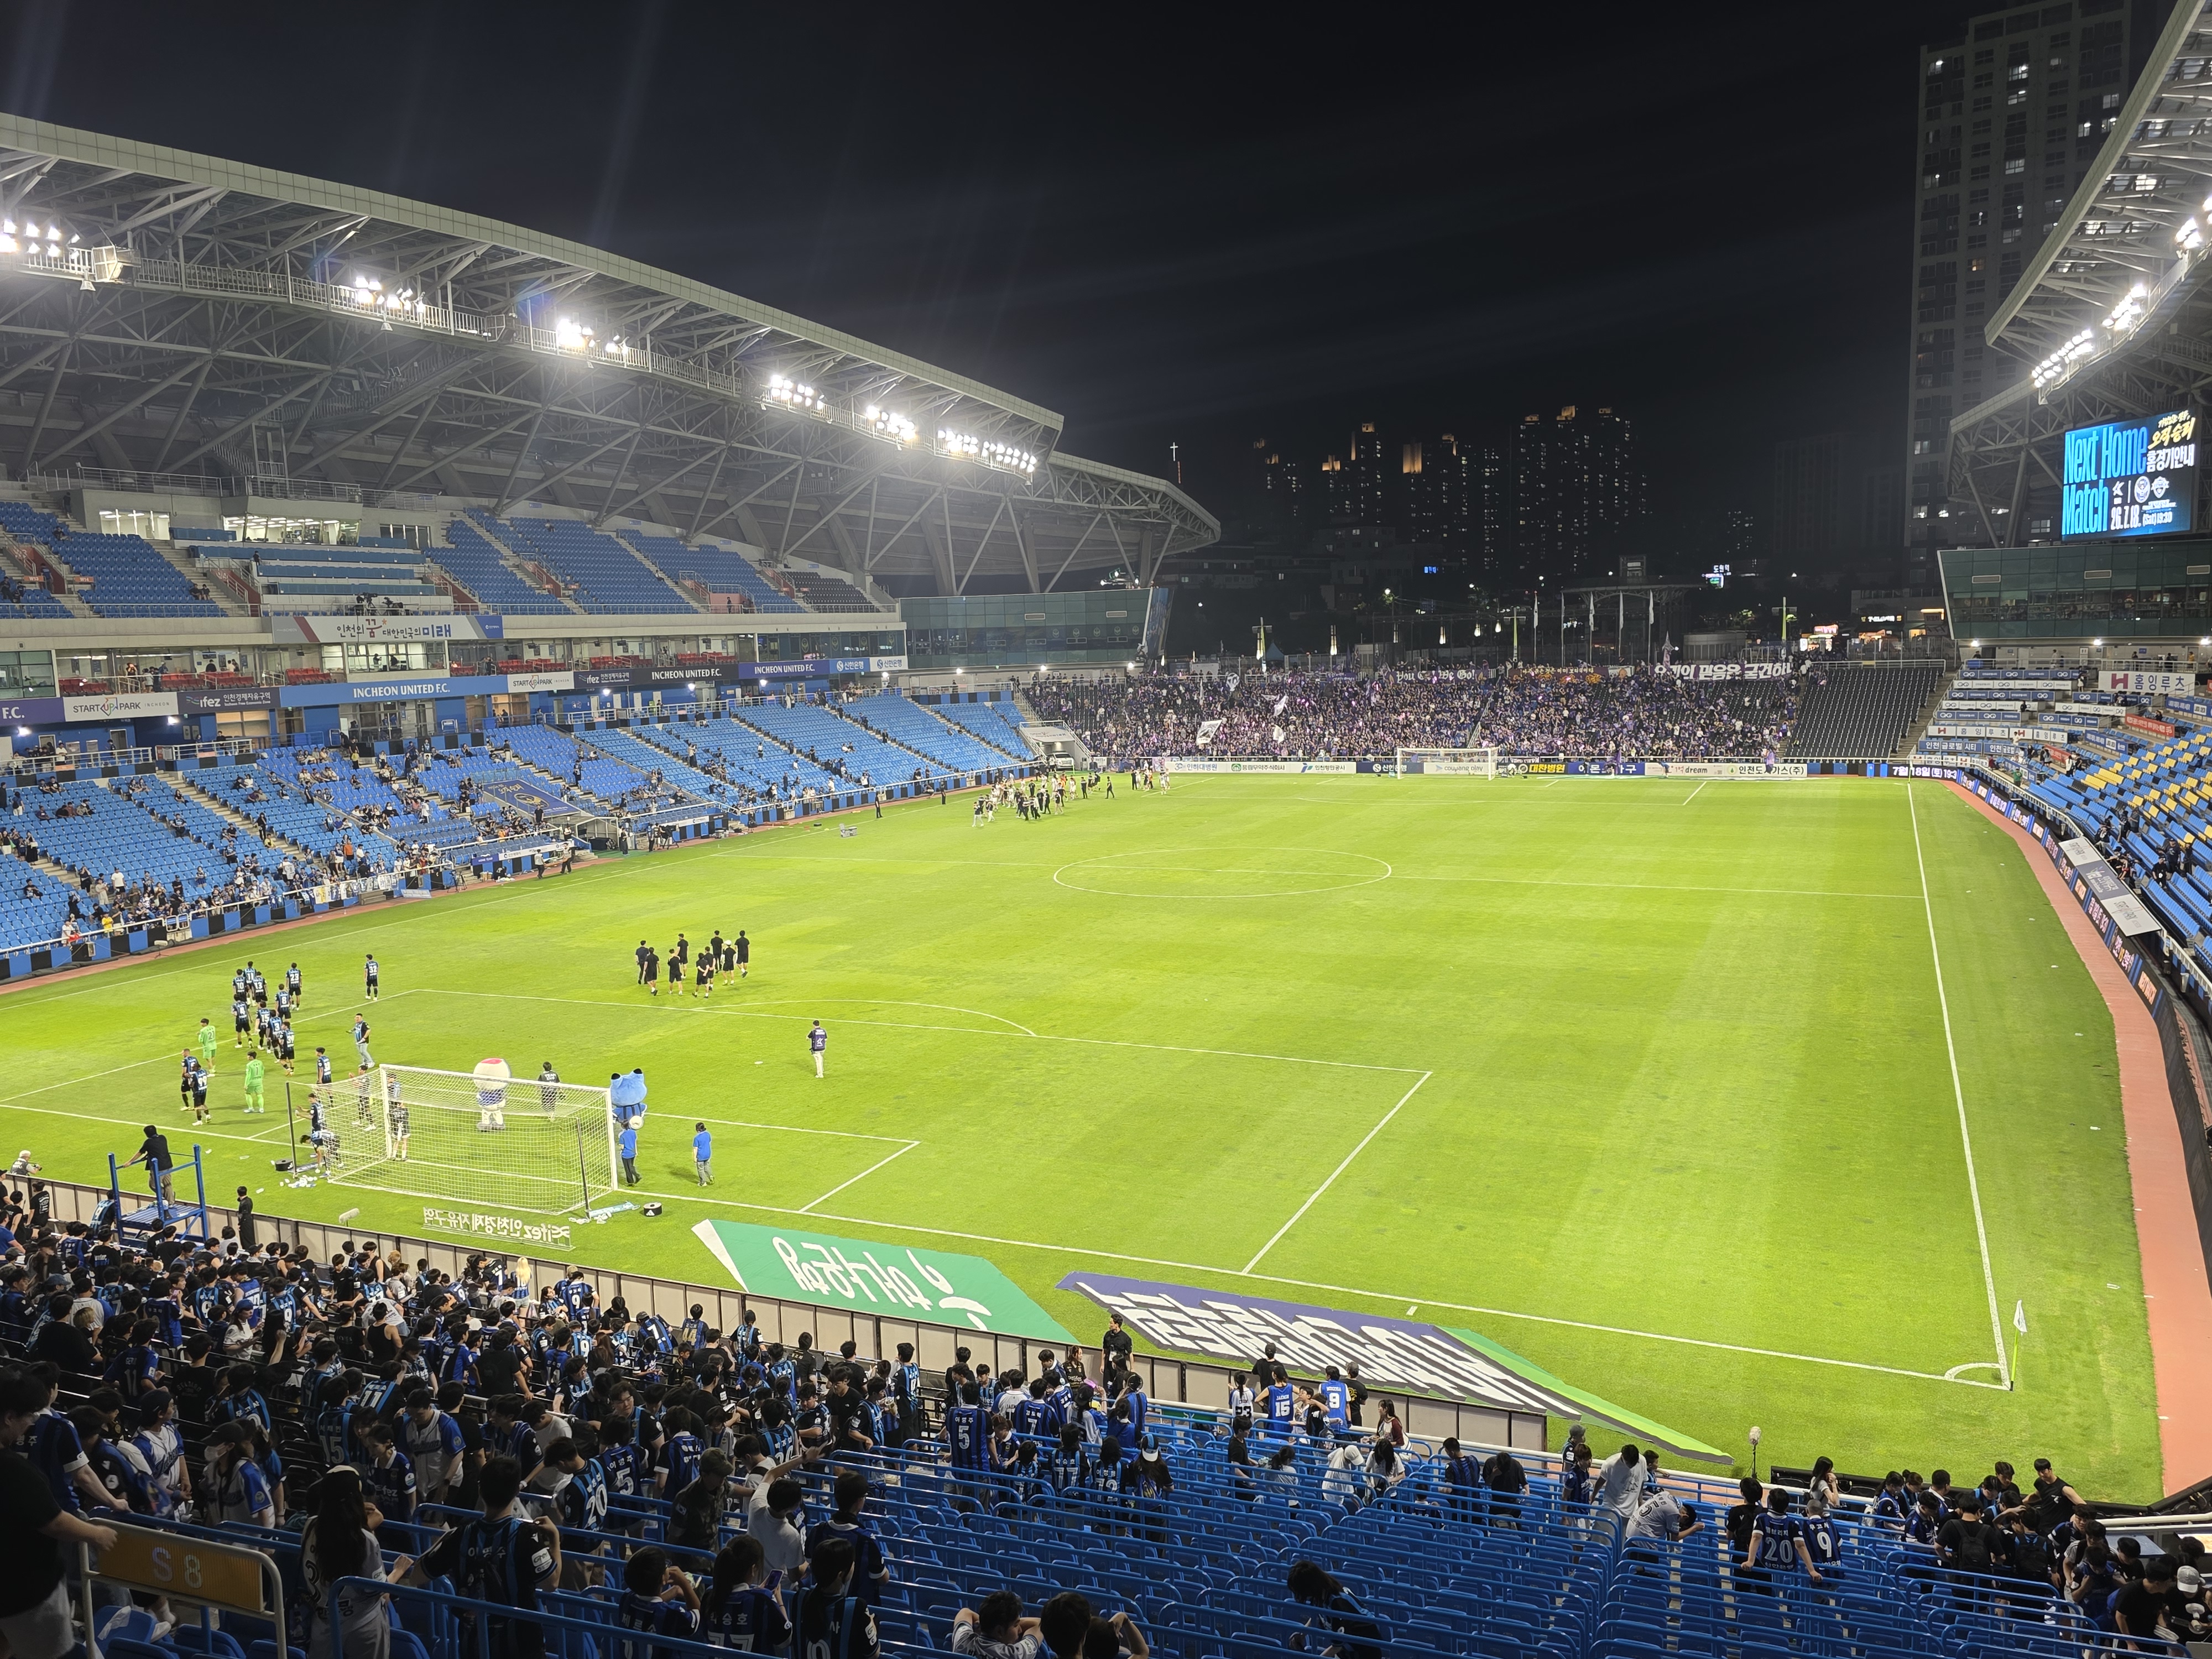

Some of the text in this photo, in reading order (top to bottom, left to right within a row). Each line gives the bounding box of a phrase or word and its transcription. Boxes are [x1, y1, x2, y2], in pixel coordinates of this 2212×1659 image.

[2148, 417, 2195, 450] 오직 승리
[2064, 426, 2148, 484] Next Home
[2062, 479, 2109, 535] Match
[337, 618, 452, 639] 인천의 꿈 대한민국의 미래
[754, 664, 816, 675] INCHEON UNITED F.C.
[844, 661, 864, 670] 신한은행
[884, 659, 902, 669] 신한은행
[651, 668, 722, 680] INCHEON UNITED F.C.
[1396, 669, 1475, 684] You We Go!
[1698, 664, 1741, 680] 믿음은
[587, 674, 599, 684] ifez
[2134, 673, 2185, 691] 홈잉루츠
[353, 683, 450, 698] INCHEON UNITED F.C.
[200, 696, 221, 708] ifez
[223, 692, 271, 702] 인천경제자유구역
[2, 707, 25, 719] F.C.
[72, 704, 101, 713] START
[119, 702, 141, 711] PARK
[1926, 742, 1976, 752] 인천 글로벌 시티
[1990, 744, 2015, 754] 인천 글로벌
[1186, 763, 1218, 771] 인하대병원
[1528, 764, 1566, 773] 대찬병원
[1684, 765, 1708, 774] dream
[1738, 766, 1804, 775] 인천도가스(주)
[1911, 766, 1931, 778] 18일
[1931, 767, 1943, 779] (토)
[369, 966, 377, 974] 32
[247, 973, 254, 981] 11
[290, 973, 299, 982] 23
[236, 982, 244, 990] 10
[254, 982, 263, 990] 13
[282, 997, 287, 1005] 8
[239, 1007, 246, 1016] 4
[261, 1014, 270, 1023] 15
[275, 1022, 280, 1032] 3
[208, 1031, 215, 1041] 21
[254, 1066, 259, 1076] 1
[198, 1076, 207, 1086] 99
[572, 1293, 582, 1307] 9
[580, 1340, 590, 1358] 9
[1328, 1392, 1340, 1409] 9
[235, 1400, 259, 1417] 무고사
[1235, 1405, 1252, 1417] 23
[1275, 1401, 1290, 1417] 15
[954, 1416, 974, 1424] 이명주
[1027, 1417, 1038, 1435] 7
[958, 1425, 970, 1450] 5
[319, 1435, 345, 1464] 15
[615, 1467, 634, 1495] 5
[1053, 1467, 1078, 1489] 77
[585, 1484, 608, 1530] 20
[1639, 1500, 1660, 1518] 5
[1764, 1537, 1793, 1564] 20
[1817, 1531, 1833, 1558] 9
[152, 1546, 203, 1589] S 8
